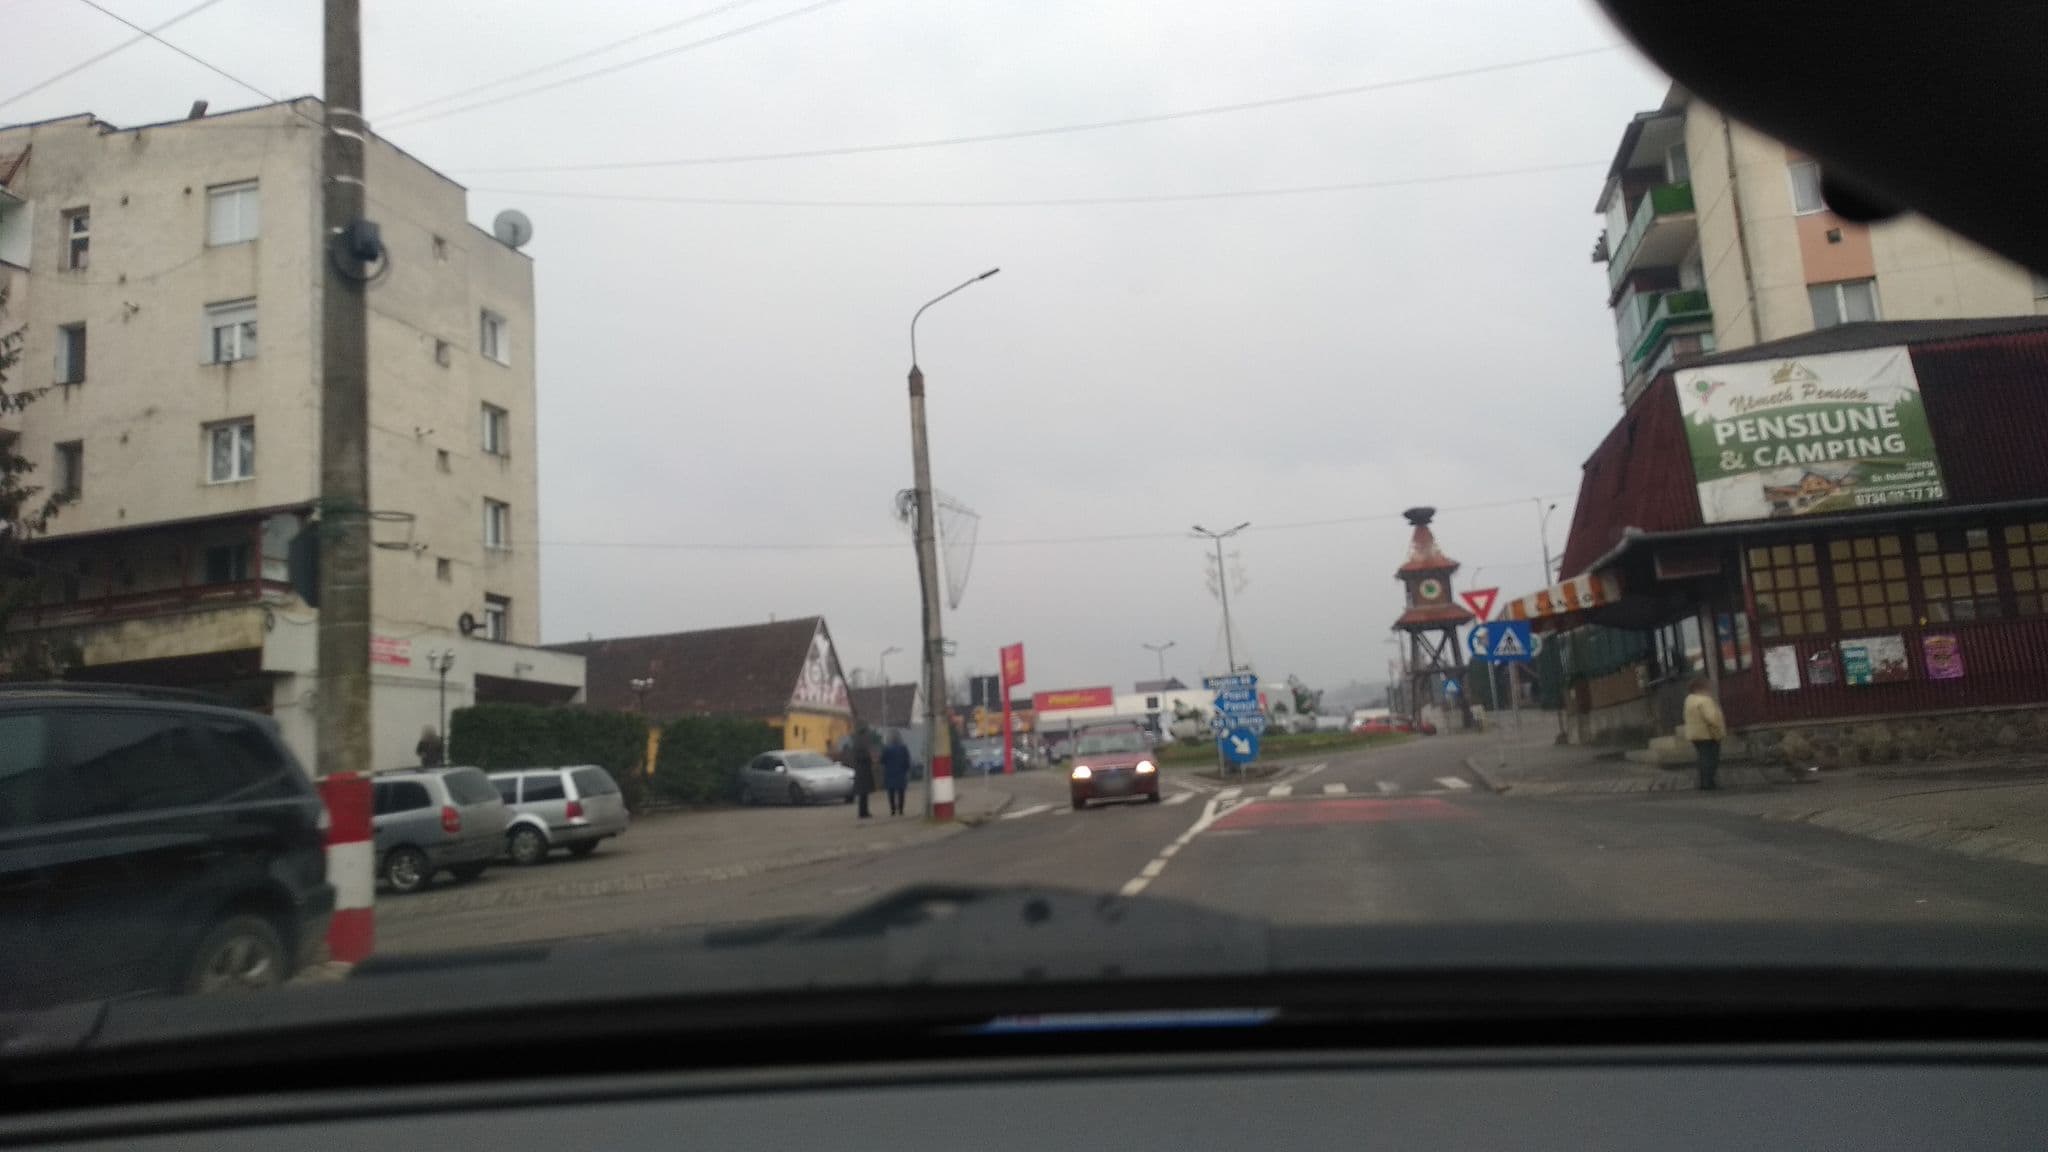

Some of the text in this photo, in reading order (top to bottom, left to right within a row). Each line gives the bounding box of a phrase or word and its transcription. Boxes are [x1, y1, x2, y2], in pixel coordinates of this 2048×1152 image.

[1714, 405, 1900, 445] PENSIUNE
[1719, 433, 1906, 470] & CAMPING
